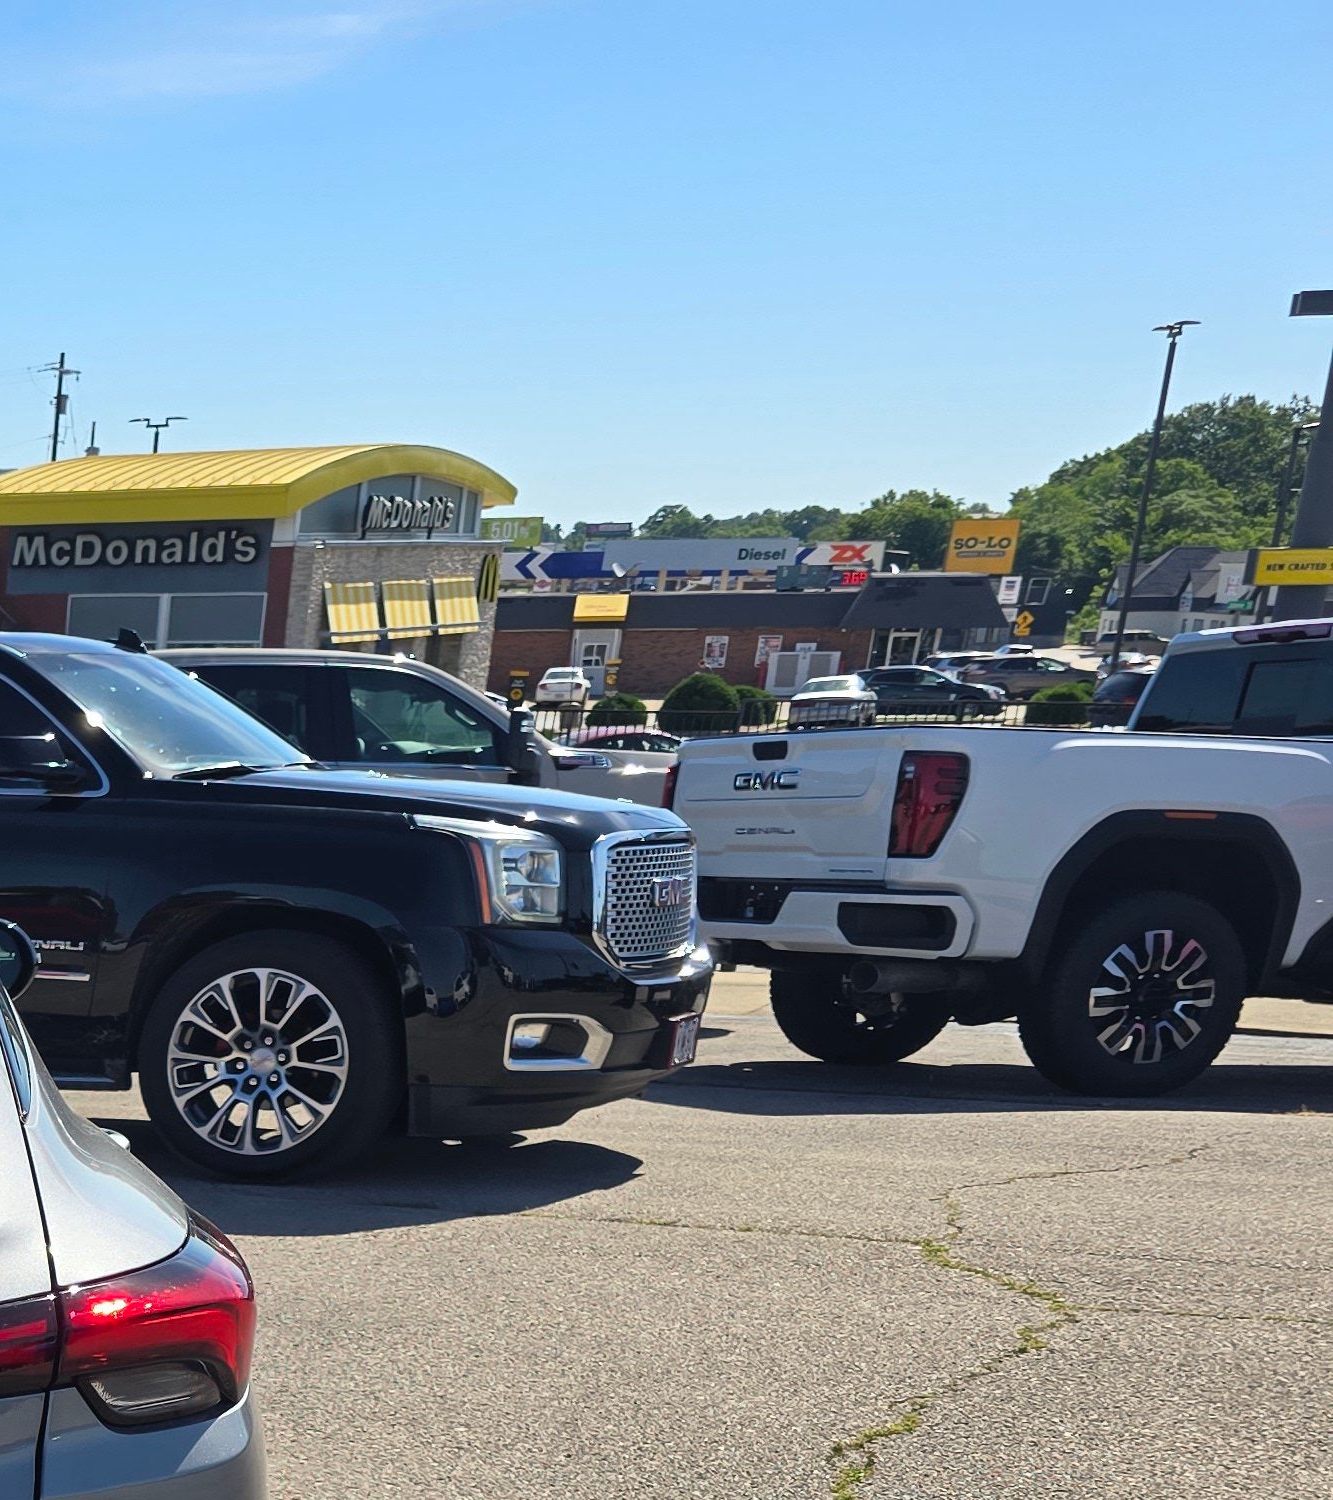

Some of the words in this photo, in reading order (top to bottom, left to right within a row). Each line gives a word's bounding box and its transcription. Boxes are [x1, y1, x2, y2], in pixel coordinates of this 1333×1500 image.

[364, 495, 454, 529] McDonald's
[11, 530, 258, 567] McDonald's
[953, 536, 1012, 550] SO-LO
[737, 547, 786, 561] Diesel
[1266, 563, 1286, 571] NEW
[1287, 562, 1327, 571] CRAFTED
[733, 768, 802, 791] GMC
